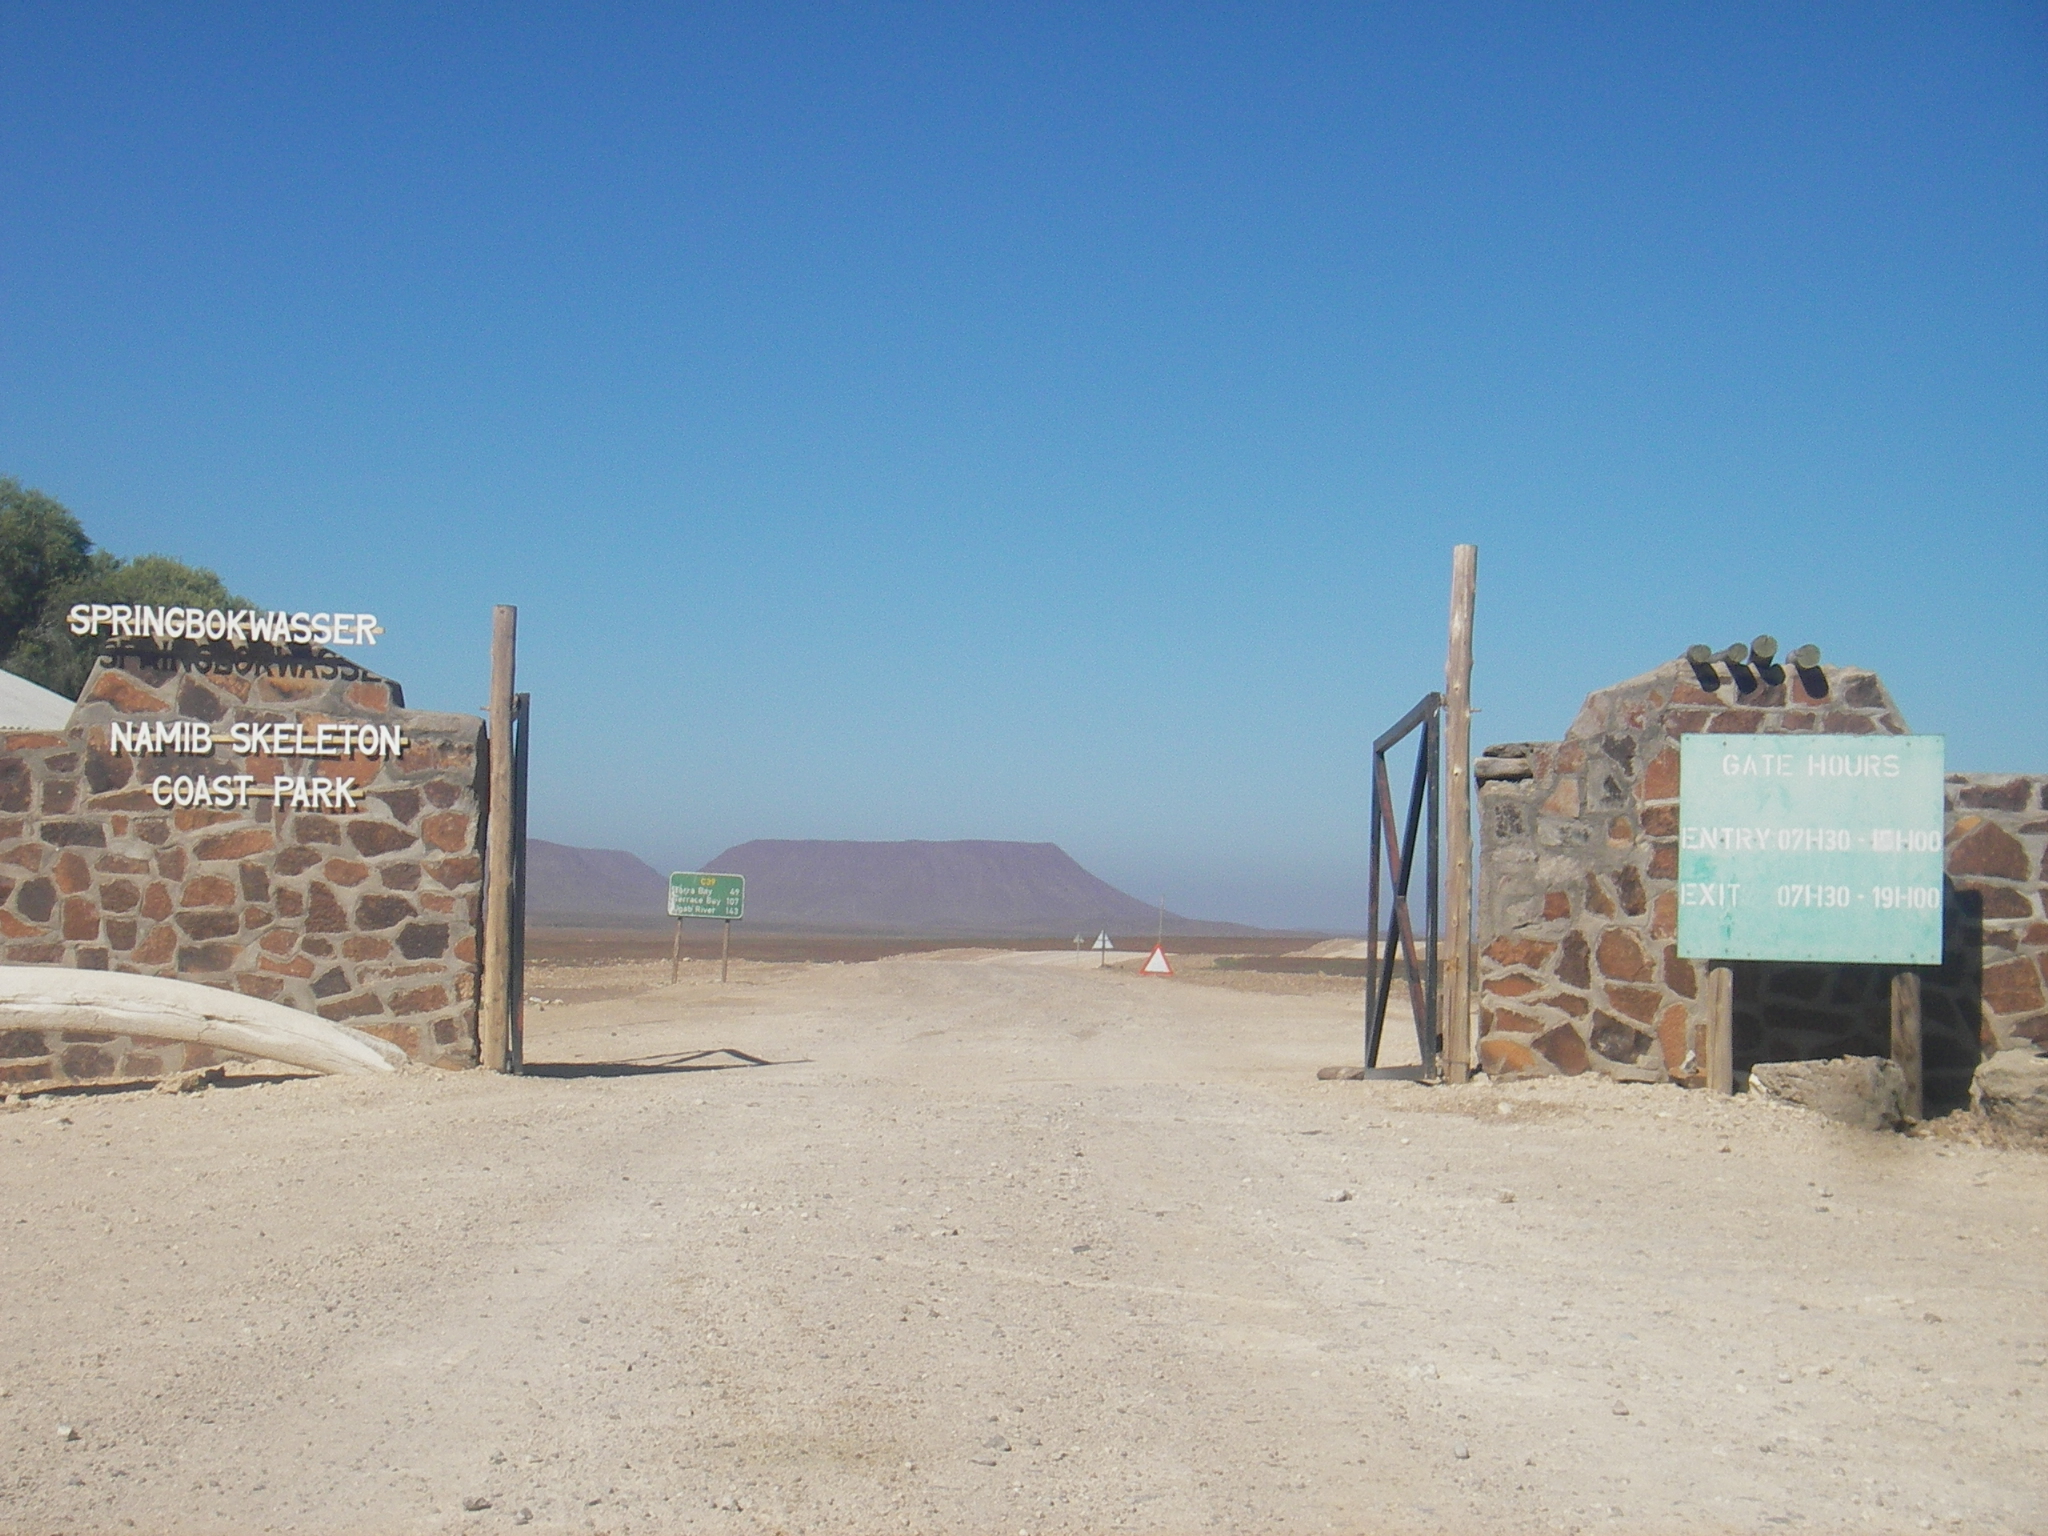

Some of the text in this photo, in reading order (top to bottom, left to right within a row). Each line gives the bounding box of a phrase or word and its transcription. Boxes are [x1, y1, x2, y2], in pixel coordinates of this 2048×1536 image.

[69, 603, 379, 646] SPRINGBOKWASSER
[110, 721, 401, 756] NAMIB SKELETON
[1721, 754, 1901, 778] GATE HOURS
[152, 774, 356, 809] COAST PARK
[1681, 826, 1771, 850] ENTRY
[1777, 828, 1851, 852] 07H30
[698, 886, 713, 897] Bay
[729, 887, 740, 896] 49
[706, 896, 722, 906] Bay
[726, 897, 739, 906] 107
[1680, 883, 1741, 907] EXIT
[1777, 884, 1851, 908] 07H30
[1872, 885, 1941, 909] 19H00
[695, 905, 716, 914] River
